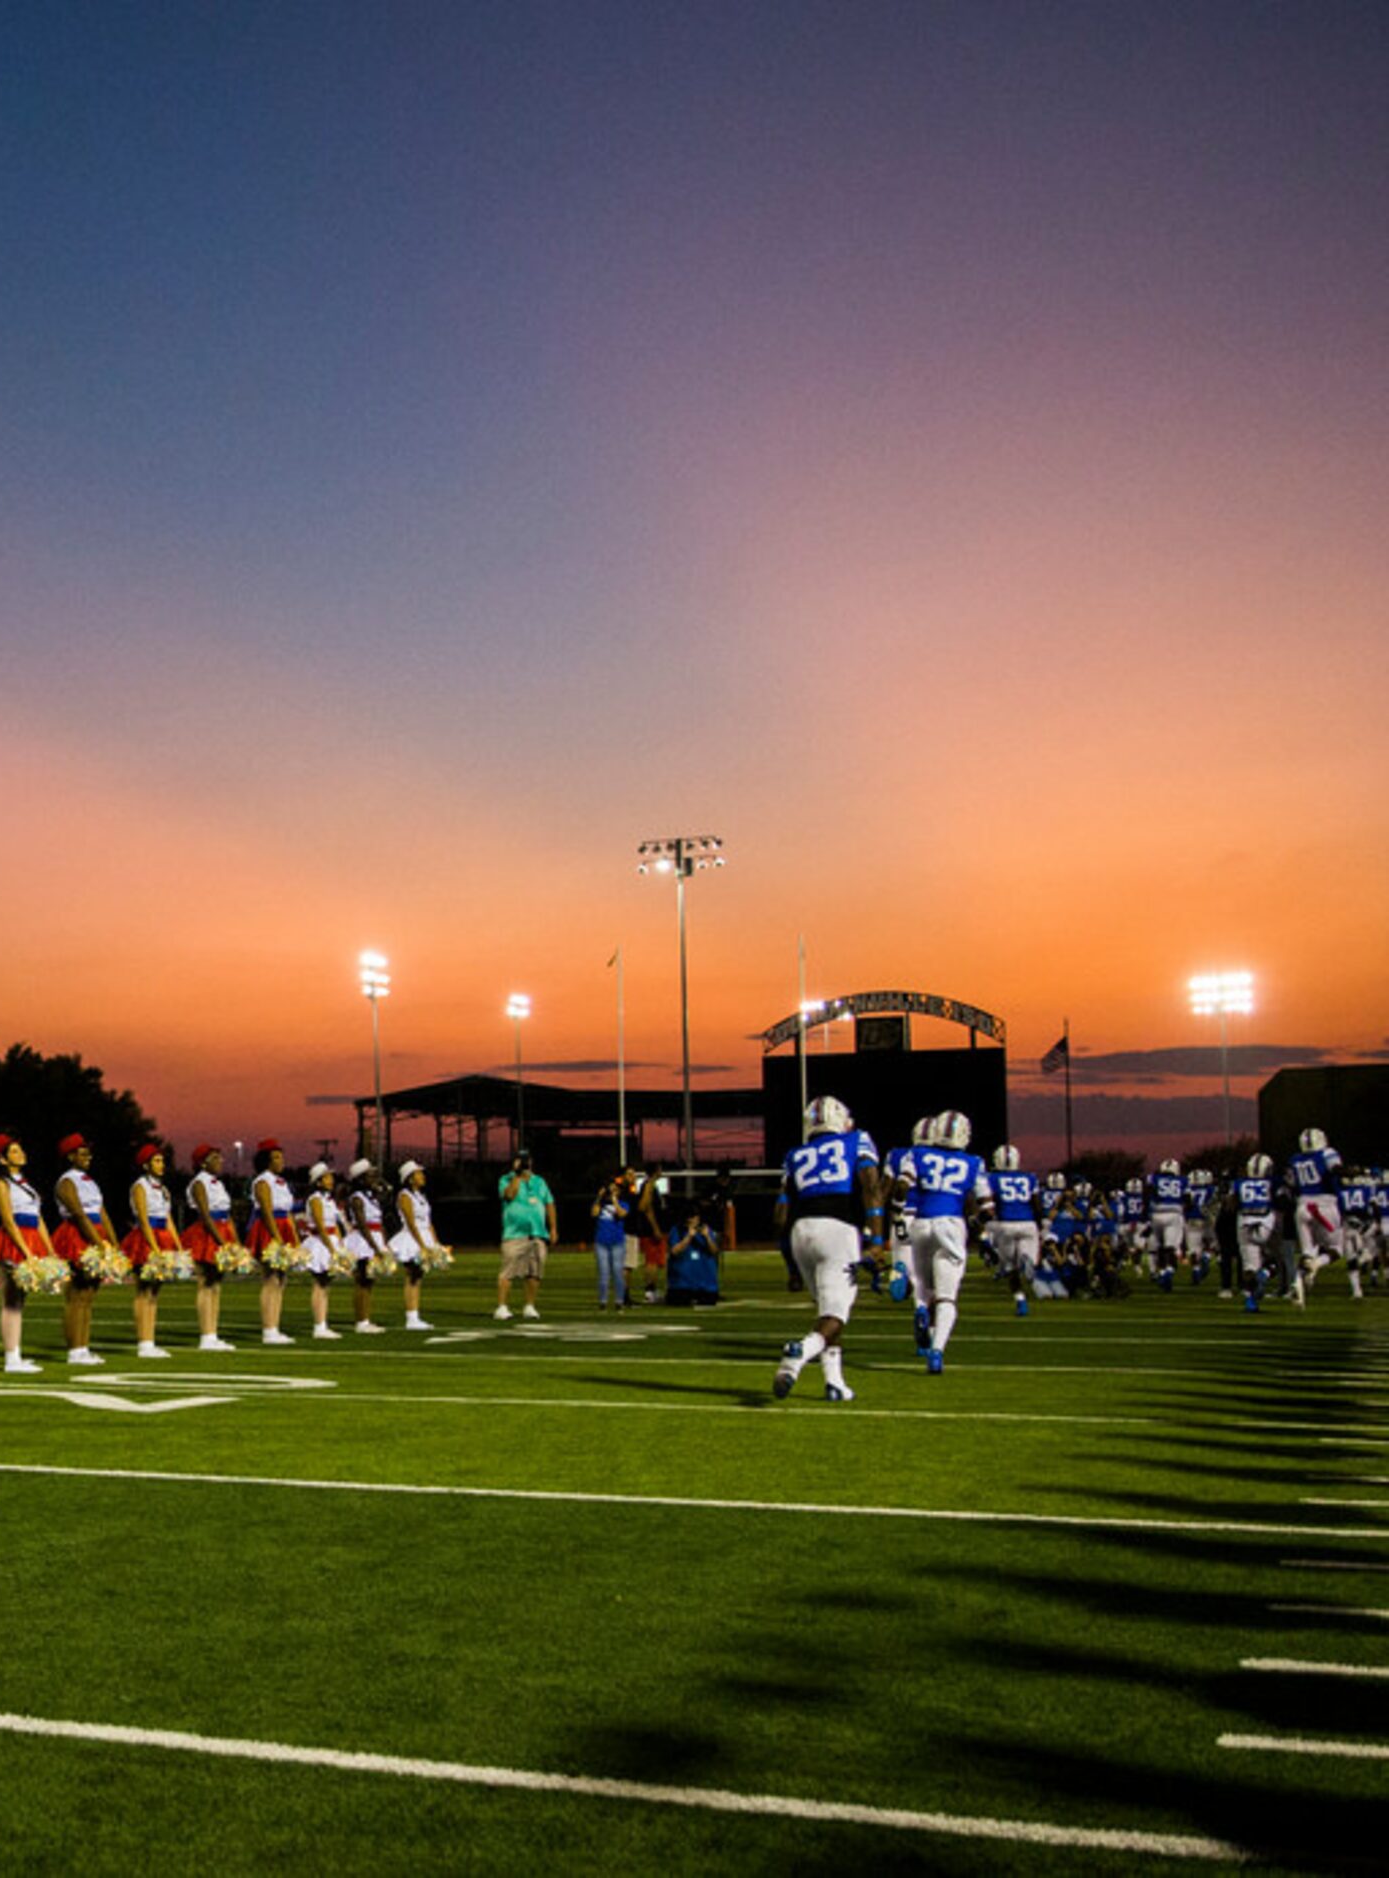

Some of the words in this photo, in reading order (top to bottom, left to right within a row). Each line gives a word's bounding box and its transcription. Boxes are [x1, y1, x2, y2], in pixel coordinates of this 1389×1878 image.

[793, 1139, 850, 1191] 23
[920, 1152, 970, 1195] 32
[1294, 1160, 1322, 1185] 10
[998, 1176, 1031, 1202] 53
[1240, 1180, 1271, 1202] 63
[1340, 1189, 1365, 1210] 14
